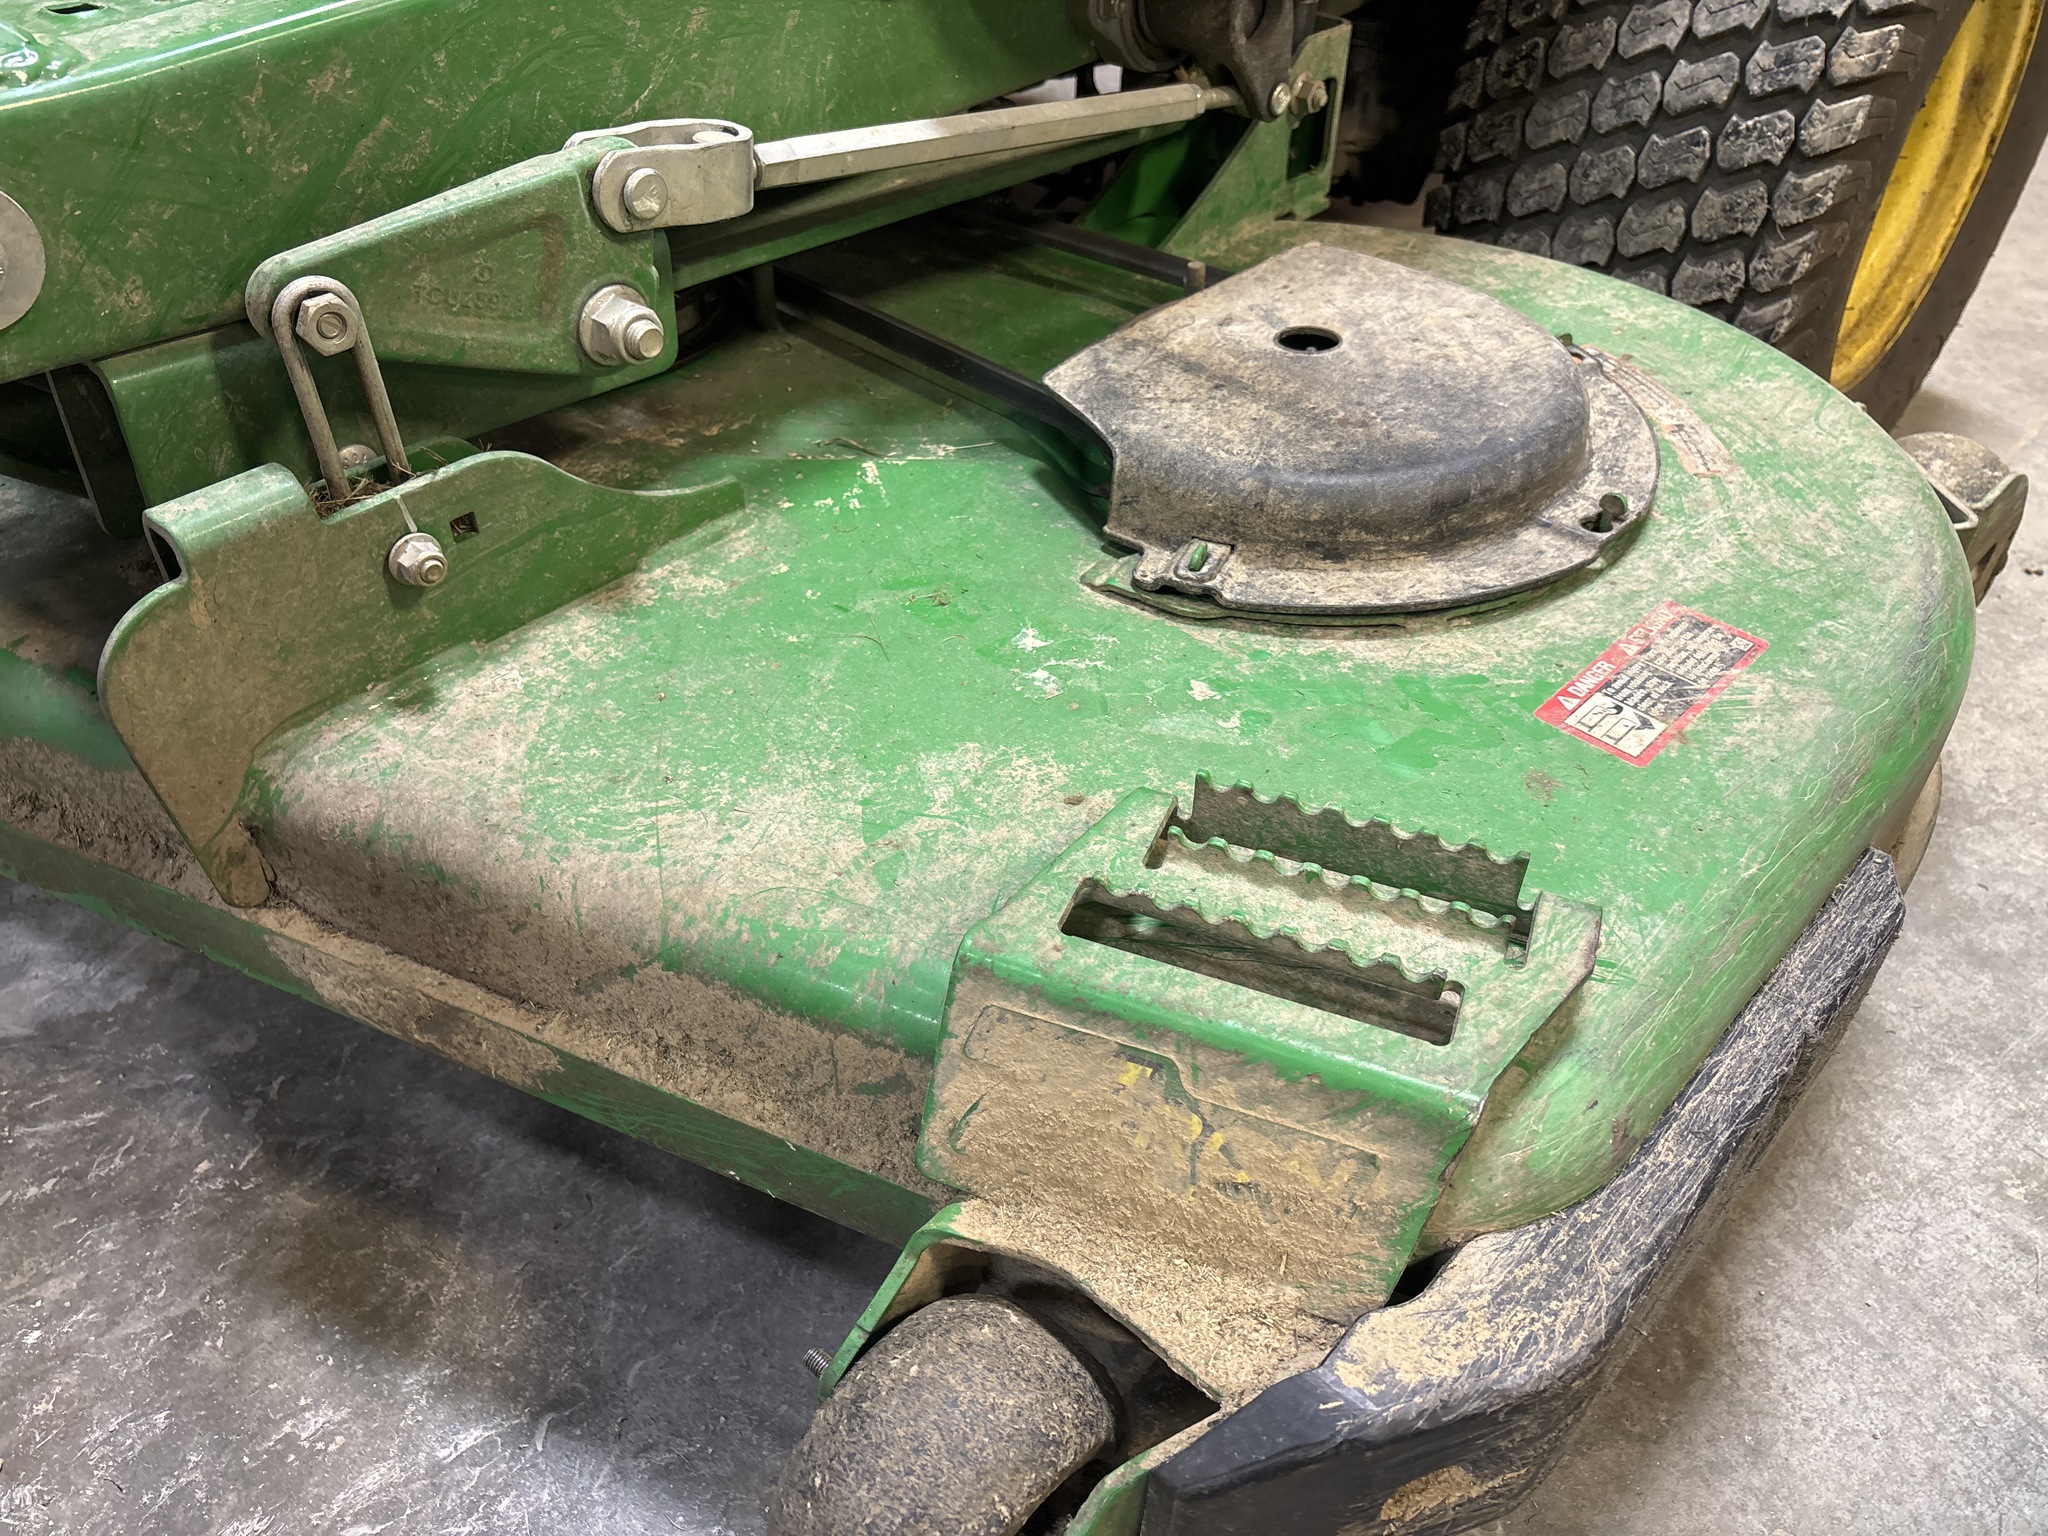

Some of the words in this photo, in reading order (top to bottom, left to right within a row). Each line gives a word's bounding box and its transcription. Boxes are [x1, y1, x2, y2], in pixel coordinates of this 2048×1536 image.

[1623, 660, 1646, 677] injury
[1569, 660, 1616, 698] DANGER
[1607, 673, 1630, 689] avoid
[1612, 686, 1632, 700] from
[1624, 669, 1653, 690] rotating
[1653, 679, 1673, 693] deck
[1600, 686, 1616, 696] To
